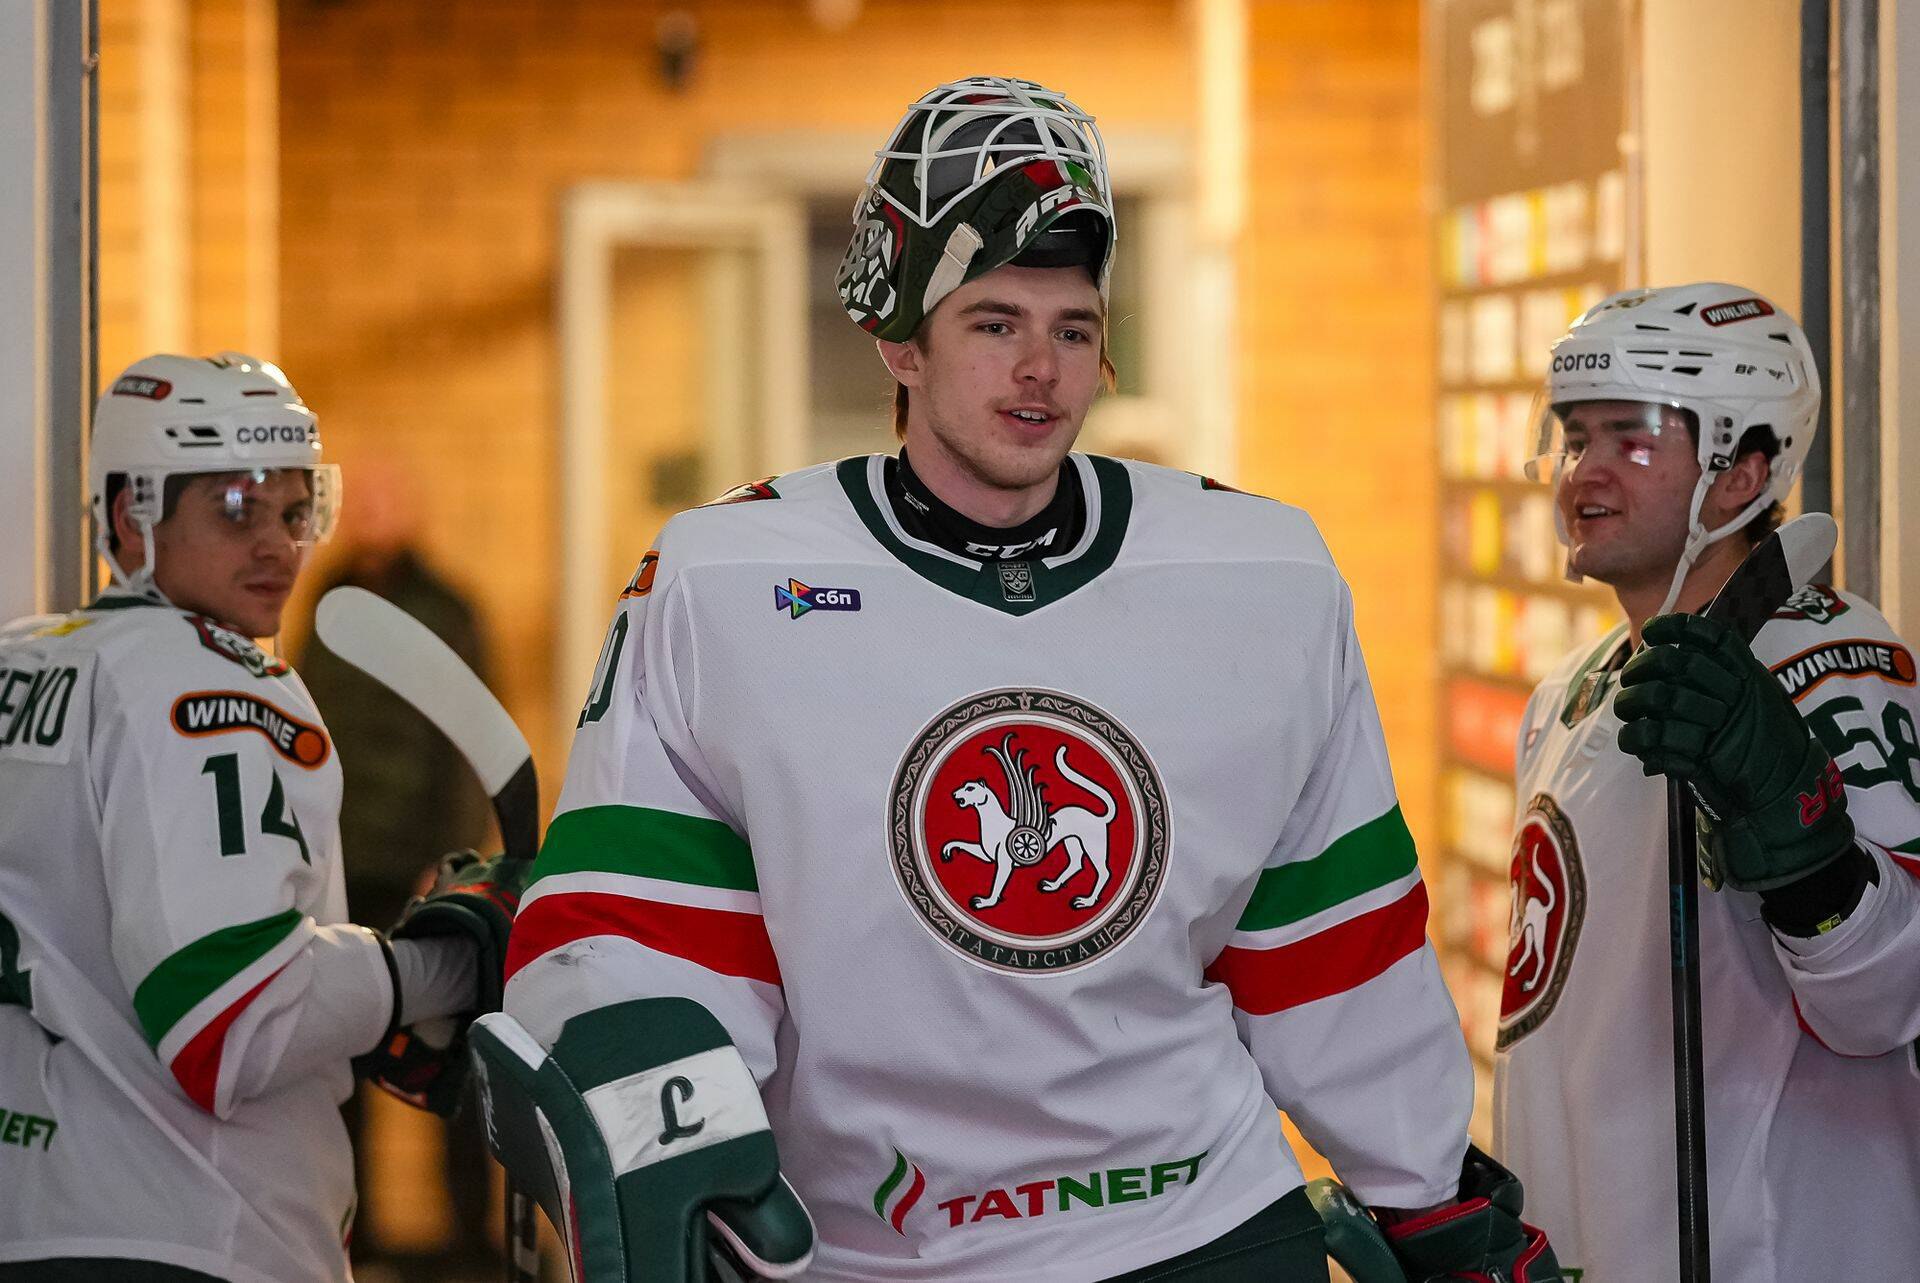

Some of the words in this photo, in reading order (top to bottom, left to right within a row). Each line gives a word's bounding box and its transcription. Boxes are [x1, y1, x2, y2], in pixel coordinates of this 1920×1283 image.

[1553, 352, 1611, 373] согаз
[236, 425, 306, 444] согаз
[965, 528, 1057, 559] CCM
[815, 590, 852, 605] сбп
[1777, 645, 1891, 695] WINLINE
[186, 698, 297, 751] WINLINE
[201, 752, 312, 867] 14
[955, 929, 1109, 967] ТАТАРСТАН
[0, 1108, 58, 1152] EFT
[937, 1150, 1209, 1229] TATNEFT
